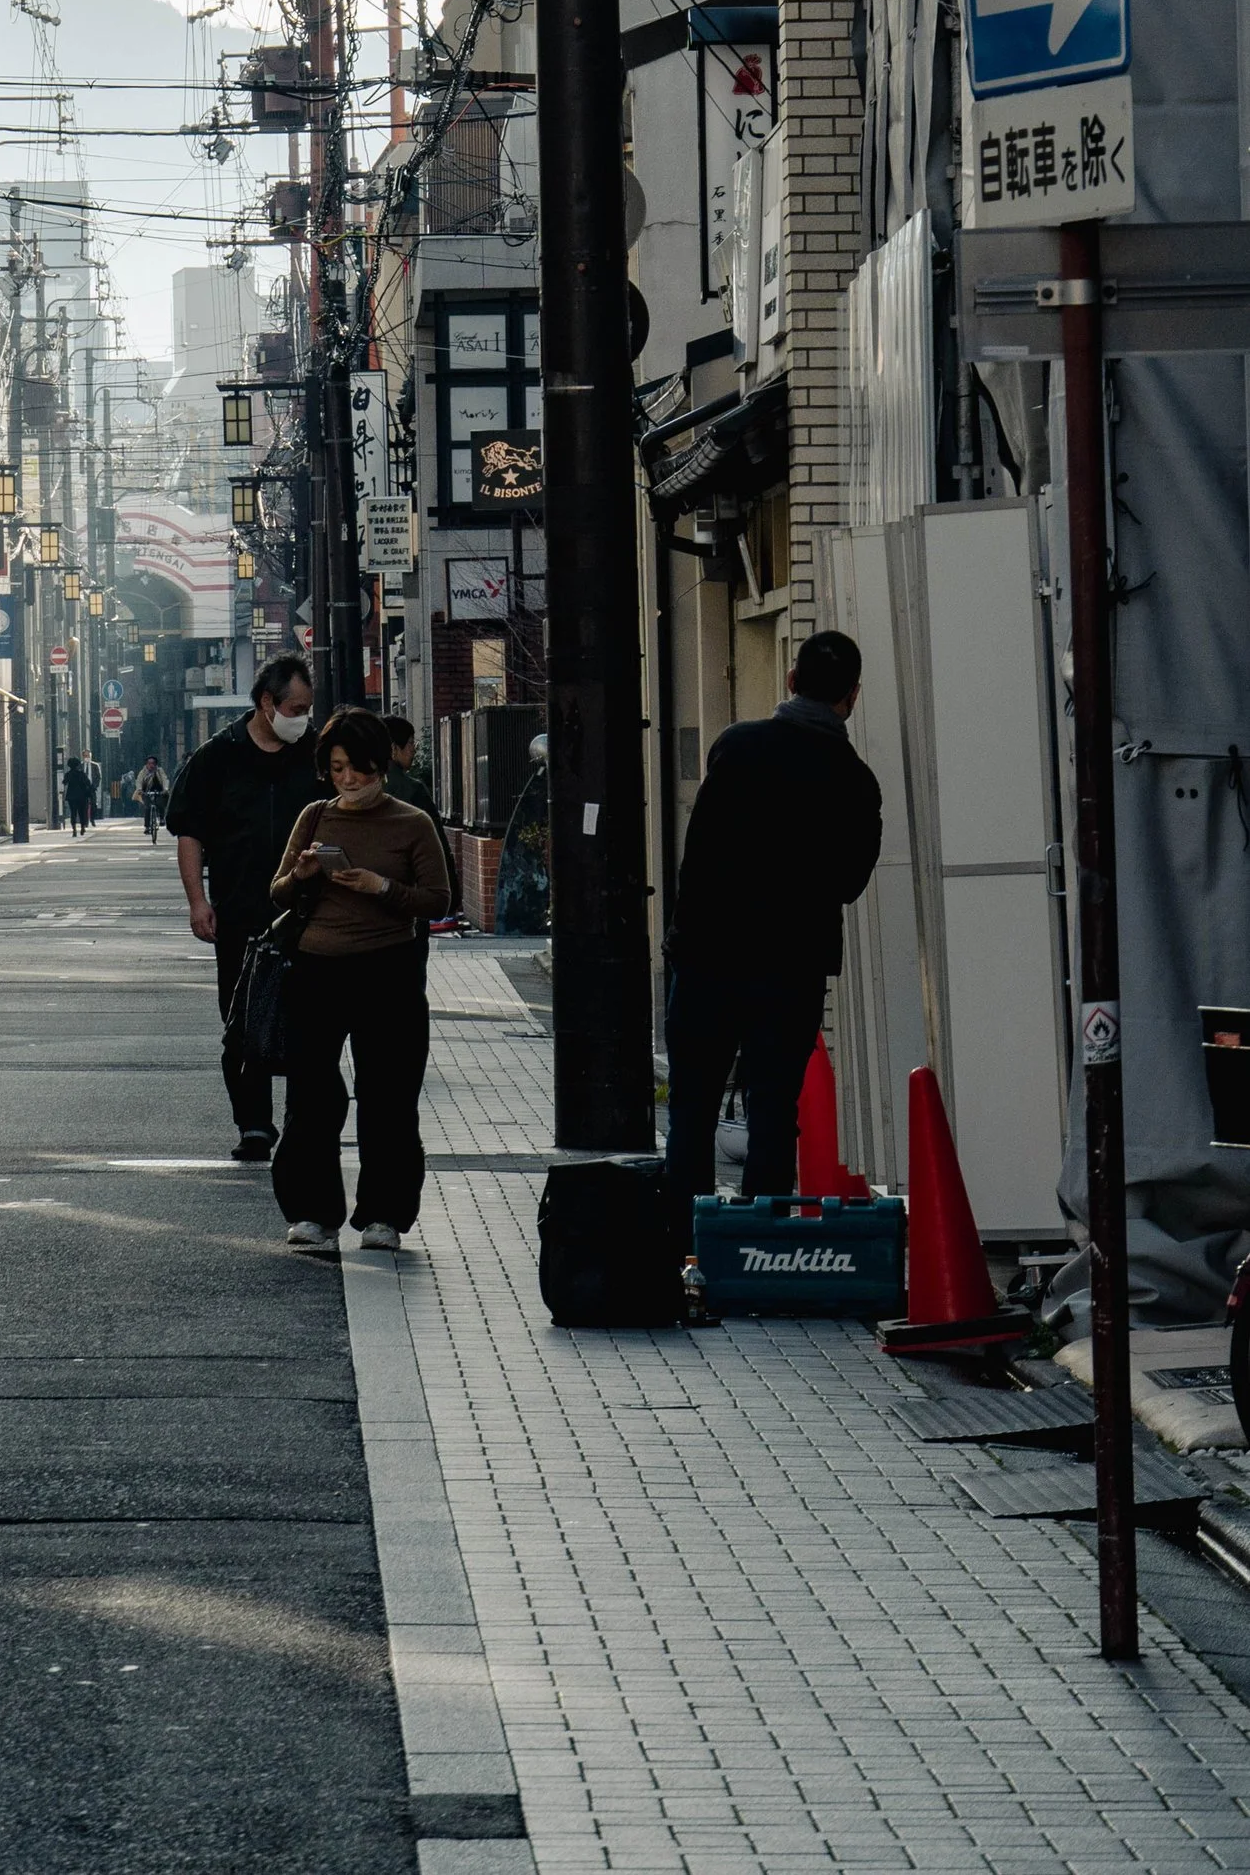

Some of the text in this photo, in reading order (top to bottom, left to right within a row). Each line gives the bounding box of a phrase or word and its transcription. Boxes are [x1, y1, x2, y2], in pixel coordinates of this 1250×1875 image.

[981, 113, 1125, 202] 自転車を除く
[480, 481, 543, 498] IL BISONTE
[373, 537, 399, 546] LACQUER
[451, 588, 488, 600] YMCA
[739, 1247, 857, 1272] Makita
